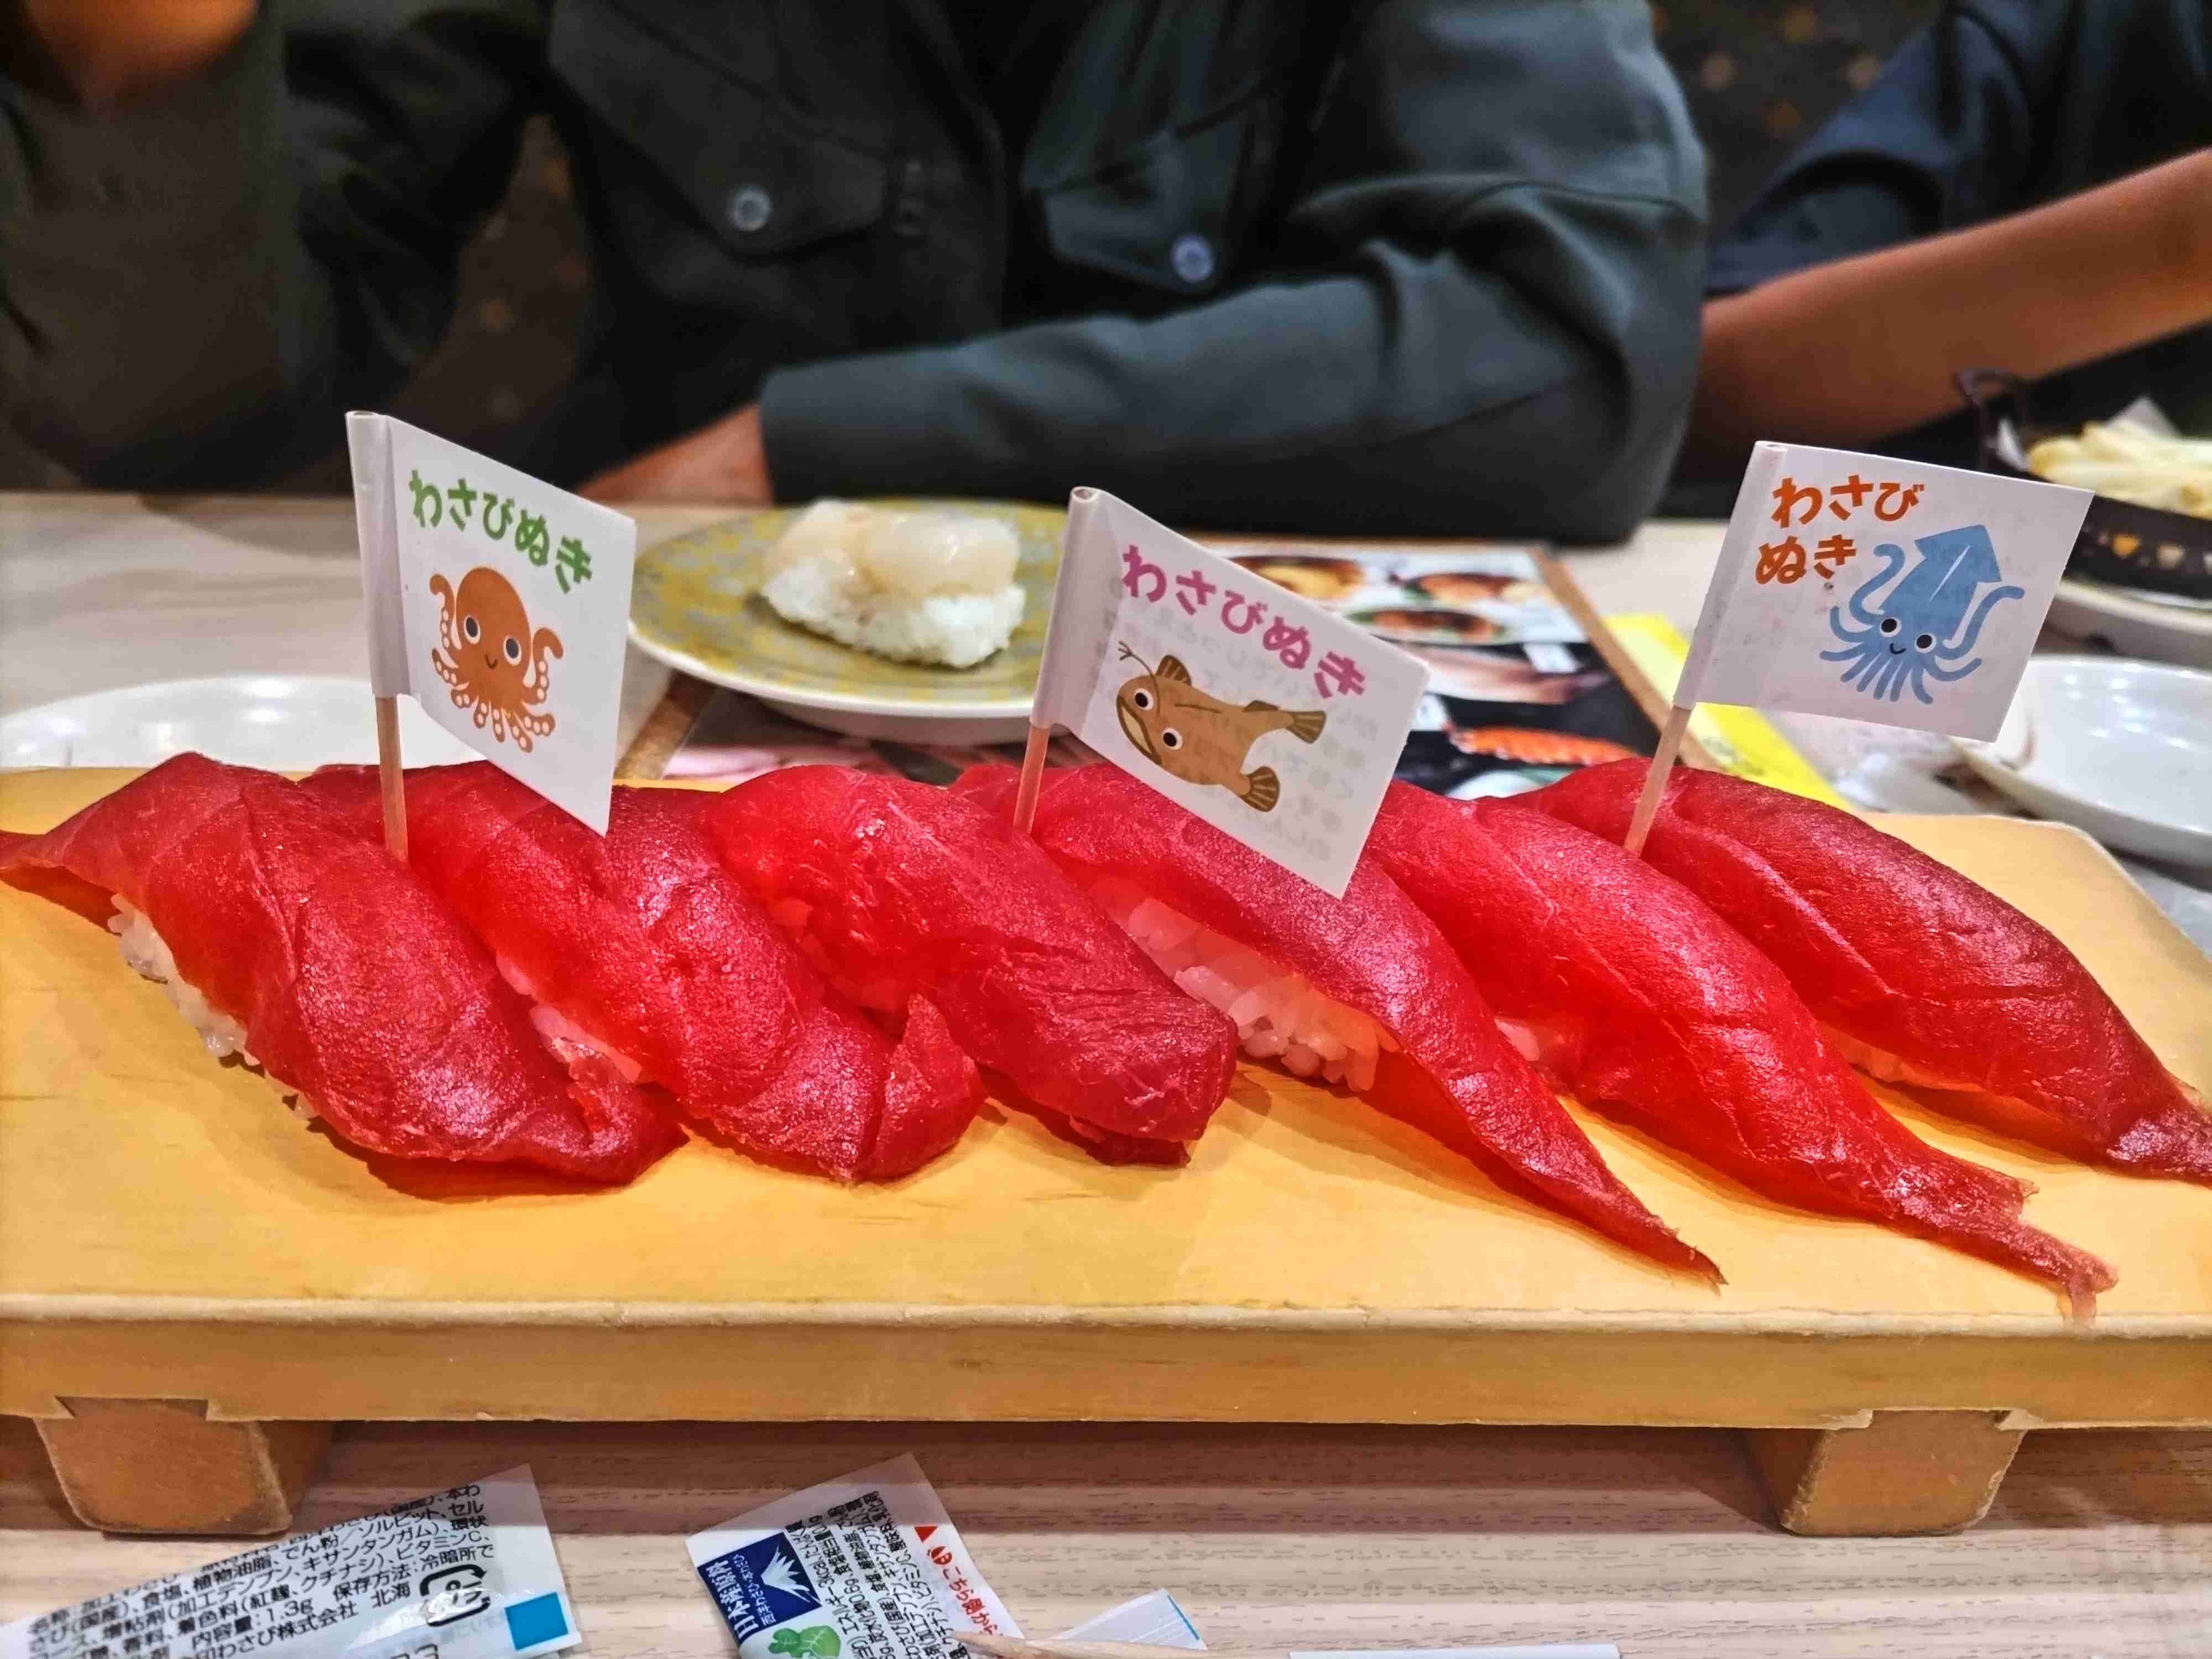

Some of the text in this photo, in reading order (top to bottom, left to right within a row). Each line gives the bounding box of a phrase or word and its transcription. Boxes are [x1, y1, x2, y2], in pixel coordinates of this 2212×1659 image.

[409, 469, 593, 594] わさびぬき
[1771, 475, 1924, 528] わさび
[1755, 535, 1857, 585] ぬき
[1123, 545, 1365, 699] わさびぬき
